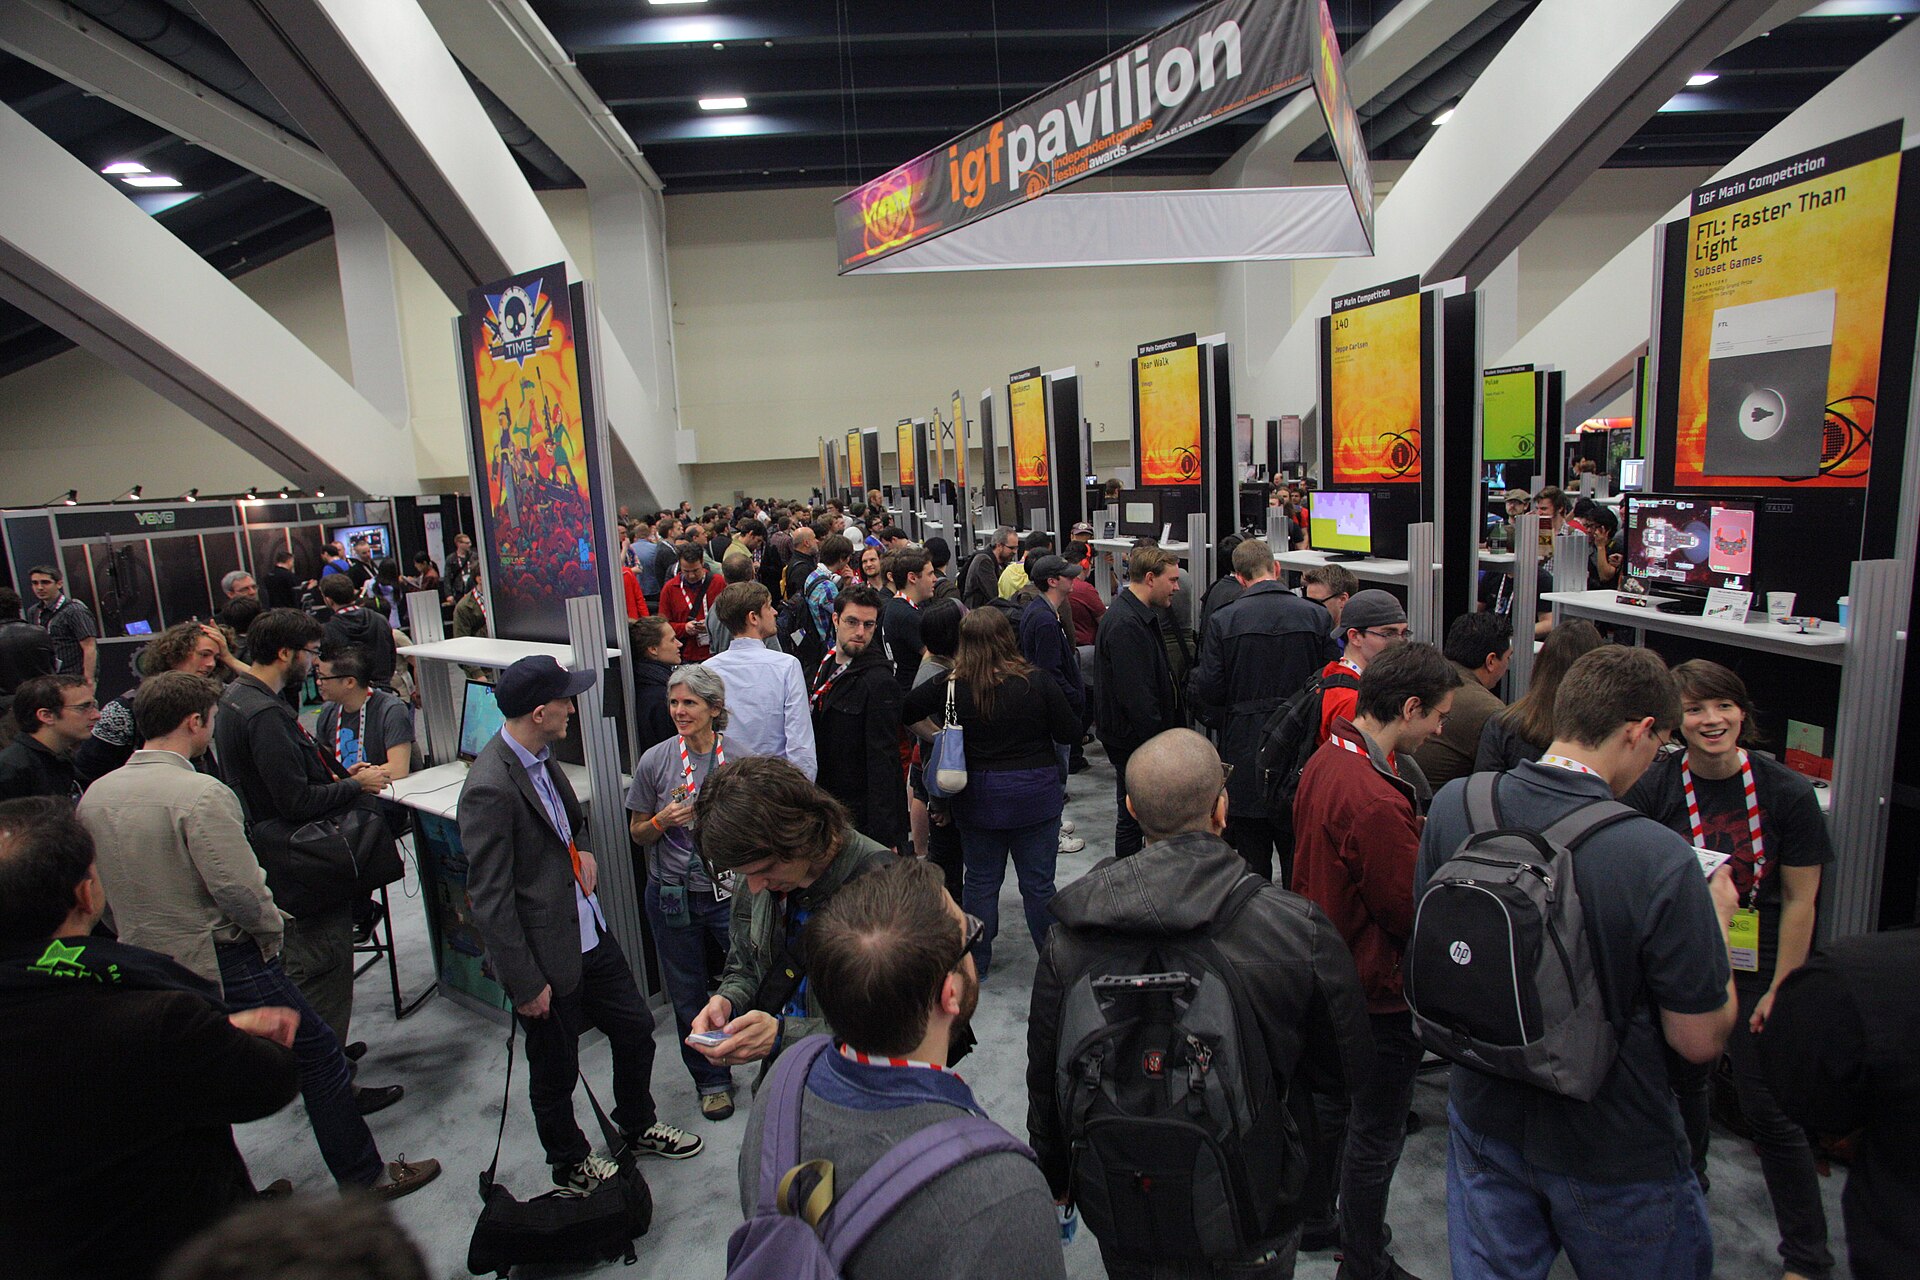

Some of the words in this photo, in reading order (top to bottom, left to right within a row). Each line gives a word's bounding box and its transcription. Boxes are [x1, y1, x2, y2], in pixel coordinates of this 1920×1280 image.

[1054, 118, 1153, 169] independentgames
[1698, 190, 1717, 206] IGF
[1718, 182, 1746, 200] Main
[1748, 156, 1826, 190] Competition
[1696, 220, 1727, 241] FTL:
[1731, 201, 1792, 232] Faster
[1798, 186, 1847, 212] Than
[1695, 235, 1738, 262] Light
[1693, 262, 1727, 278] Subset
[1729, 254, 1763, 270] Games
[1334, 301, 1344, 309] IGF
[1344, 298, 1357, 307] Main
[1357, 288, 1391, 304] Competition
[1335, 318, 1349, 331] 140
[505, 339, 533, 356] TIME
[1141, 361, 1153, 370] Year
[1153, 357, 1169, 368] Walk
[929, 420, 974, 441] EXT
[1099, 422, 1105, 433] 3
[1452, 941, 1469, 964] hp
